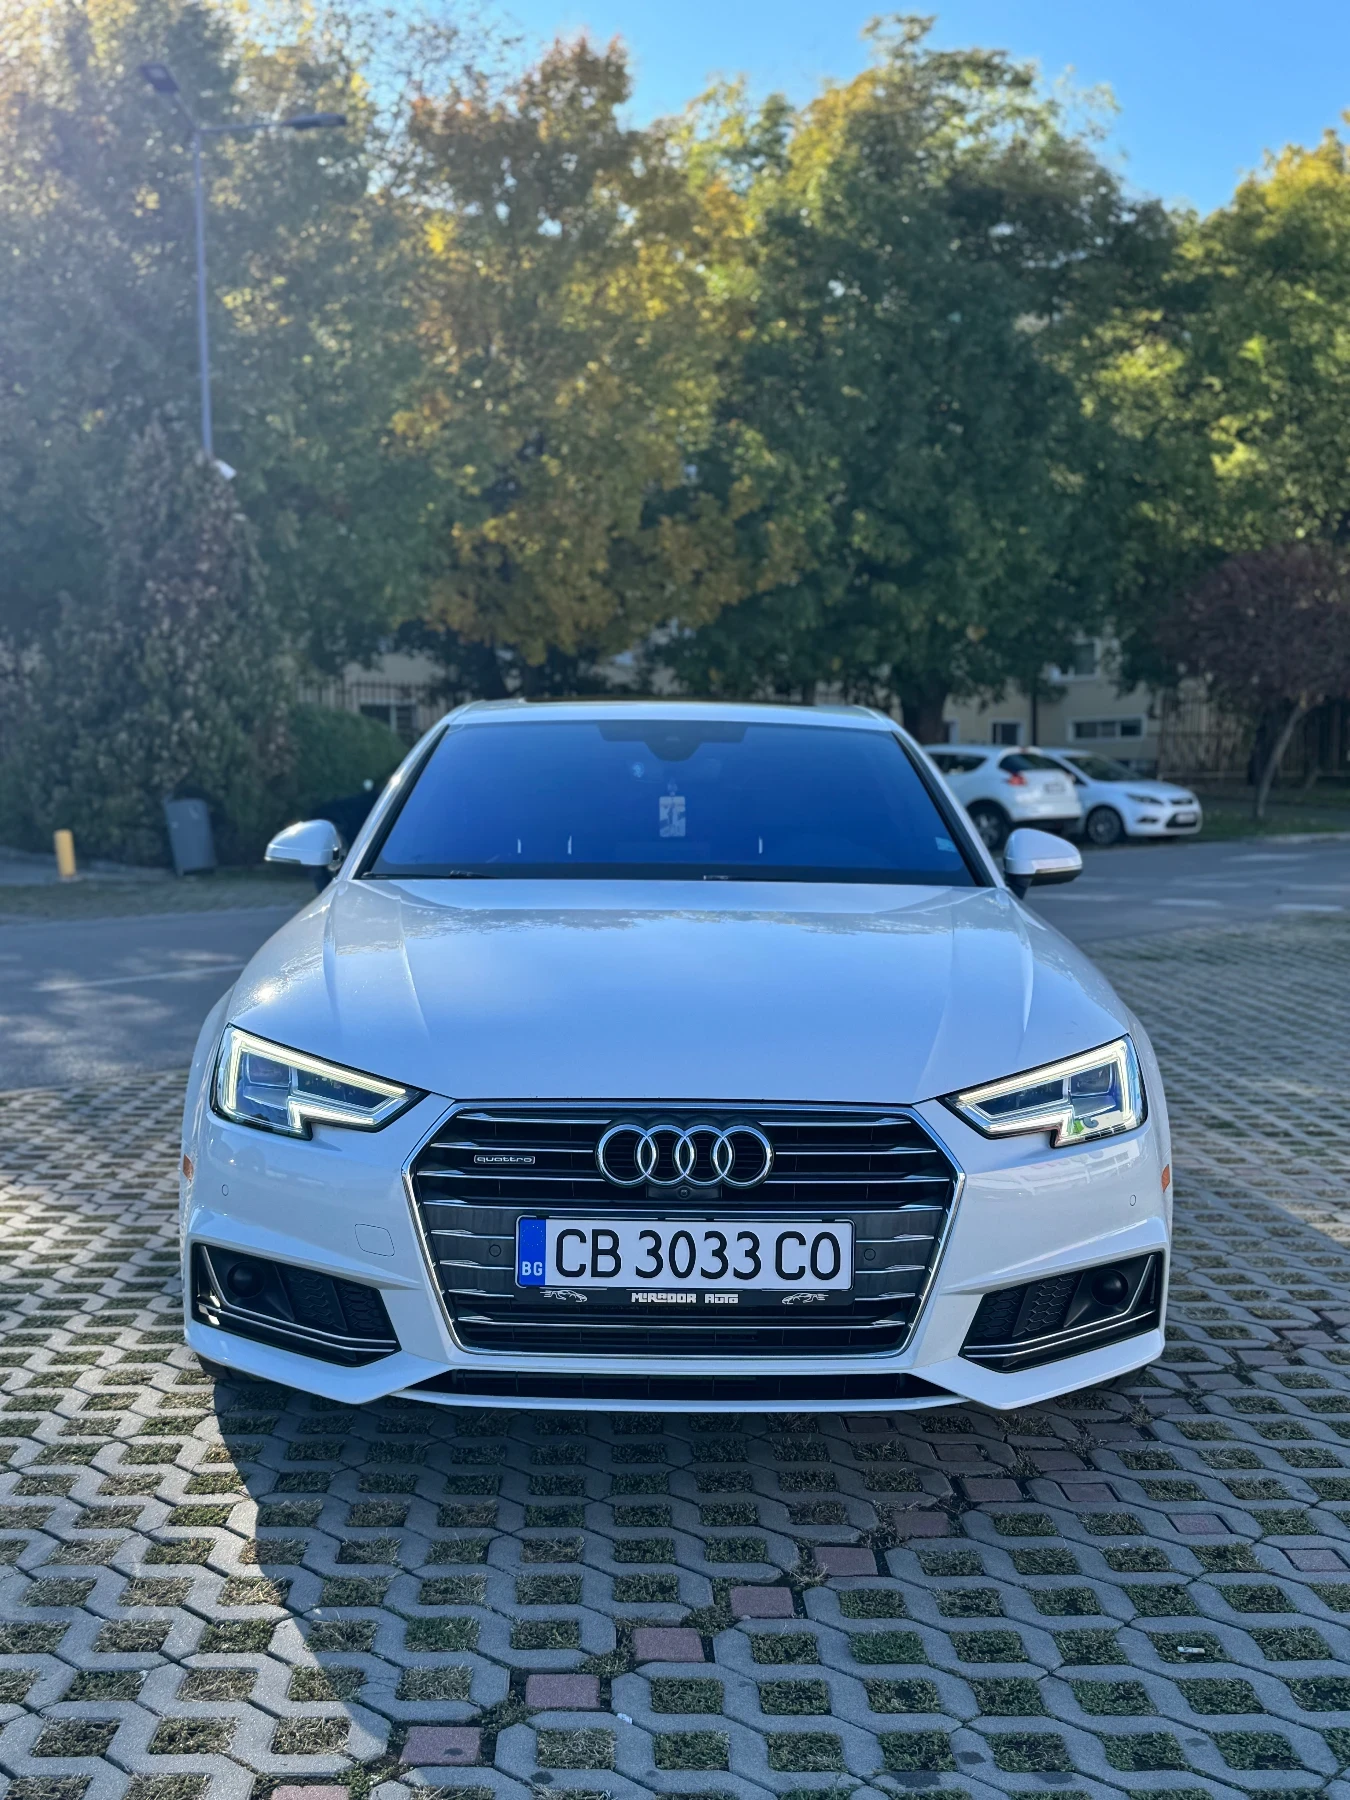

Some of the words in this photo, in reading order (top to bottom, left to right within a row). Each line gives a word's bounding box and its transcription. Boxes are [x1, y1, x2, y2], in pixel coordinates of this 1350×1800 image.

[521, 1261, 543, 1276] BG
[555, 1228, 622, 1278] CB
[635, 1229, 762, 1280] 3033
